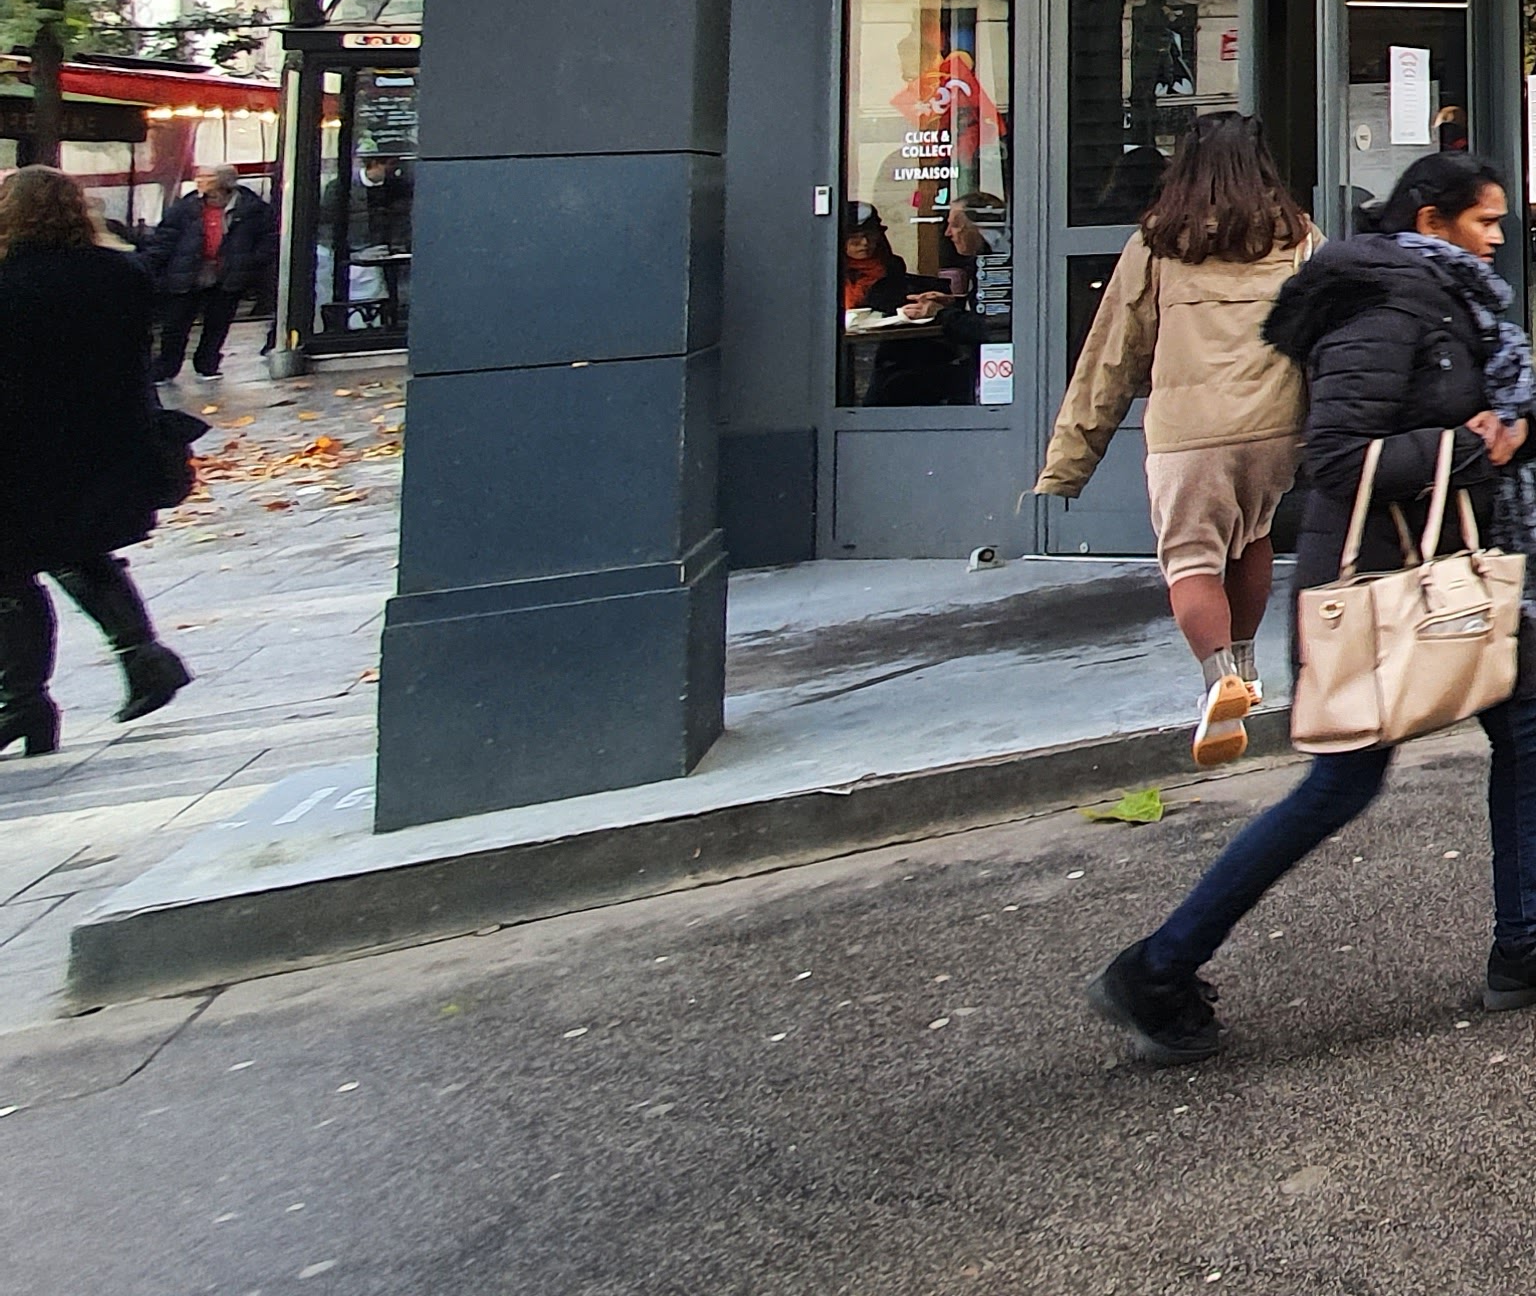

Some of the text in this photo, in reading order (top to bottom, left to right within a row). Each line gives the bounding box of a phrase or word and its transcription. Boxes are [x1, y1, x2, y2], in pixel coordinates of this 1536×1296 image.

[905, 130, 950, 144] CLICK &
[902, 144, 953, 158] COLLECT
[894, 166, 959, 181] LIVRAISON
